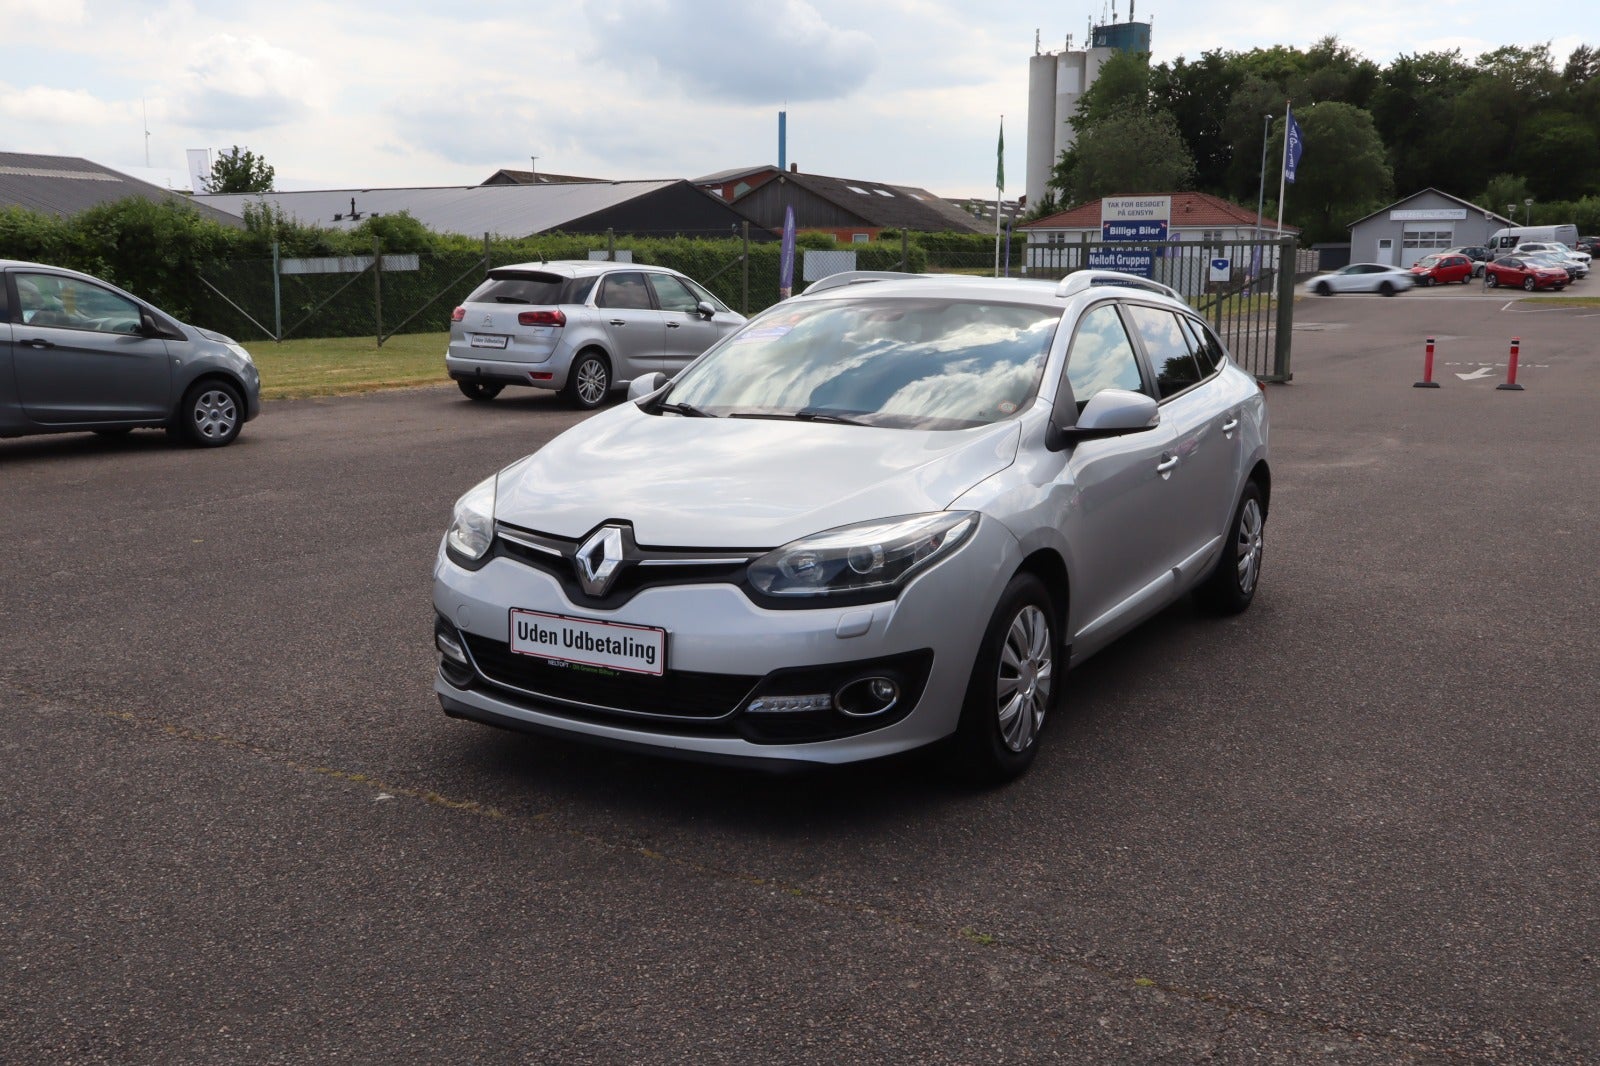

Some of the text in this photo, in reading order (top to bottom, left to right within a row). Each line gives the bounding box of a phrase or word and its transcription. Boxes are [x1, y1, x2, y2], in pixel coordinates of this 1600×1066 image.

[1127, 209, 1154, 217] GENSYN
[1109, 226, 1160, 236] Billige Biler
[1089, 254, 1150, 267] Neltoft Gruppen
[517, 620, 656, 665] Uden Udbetaling
